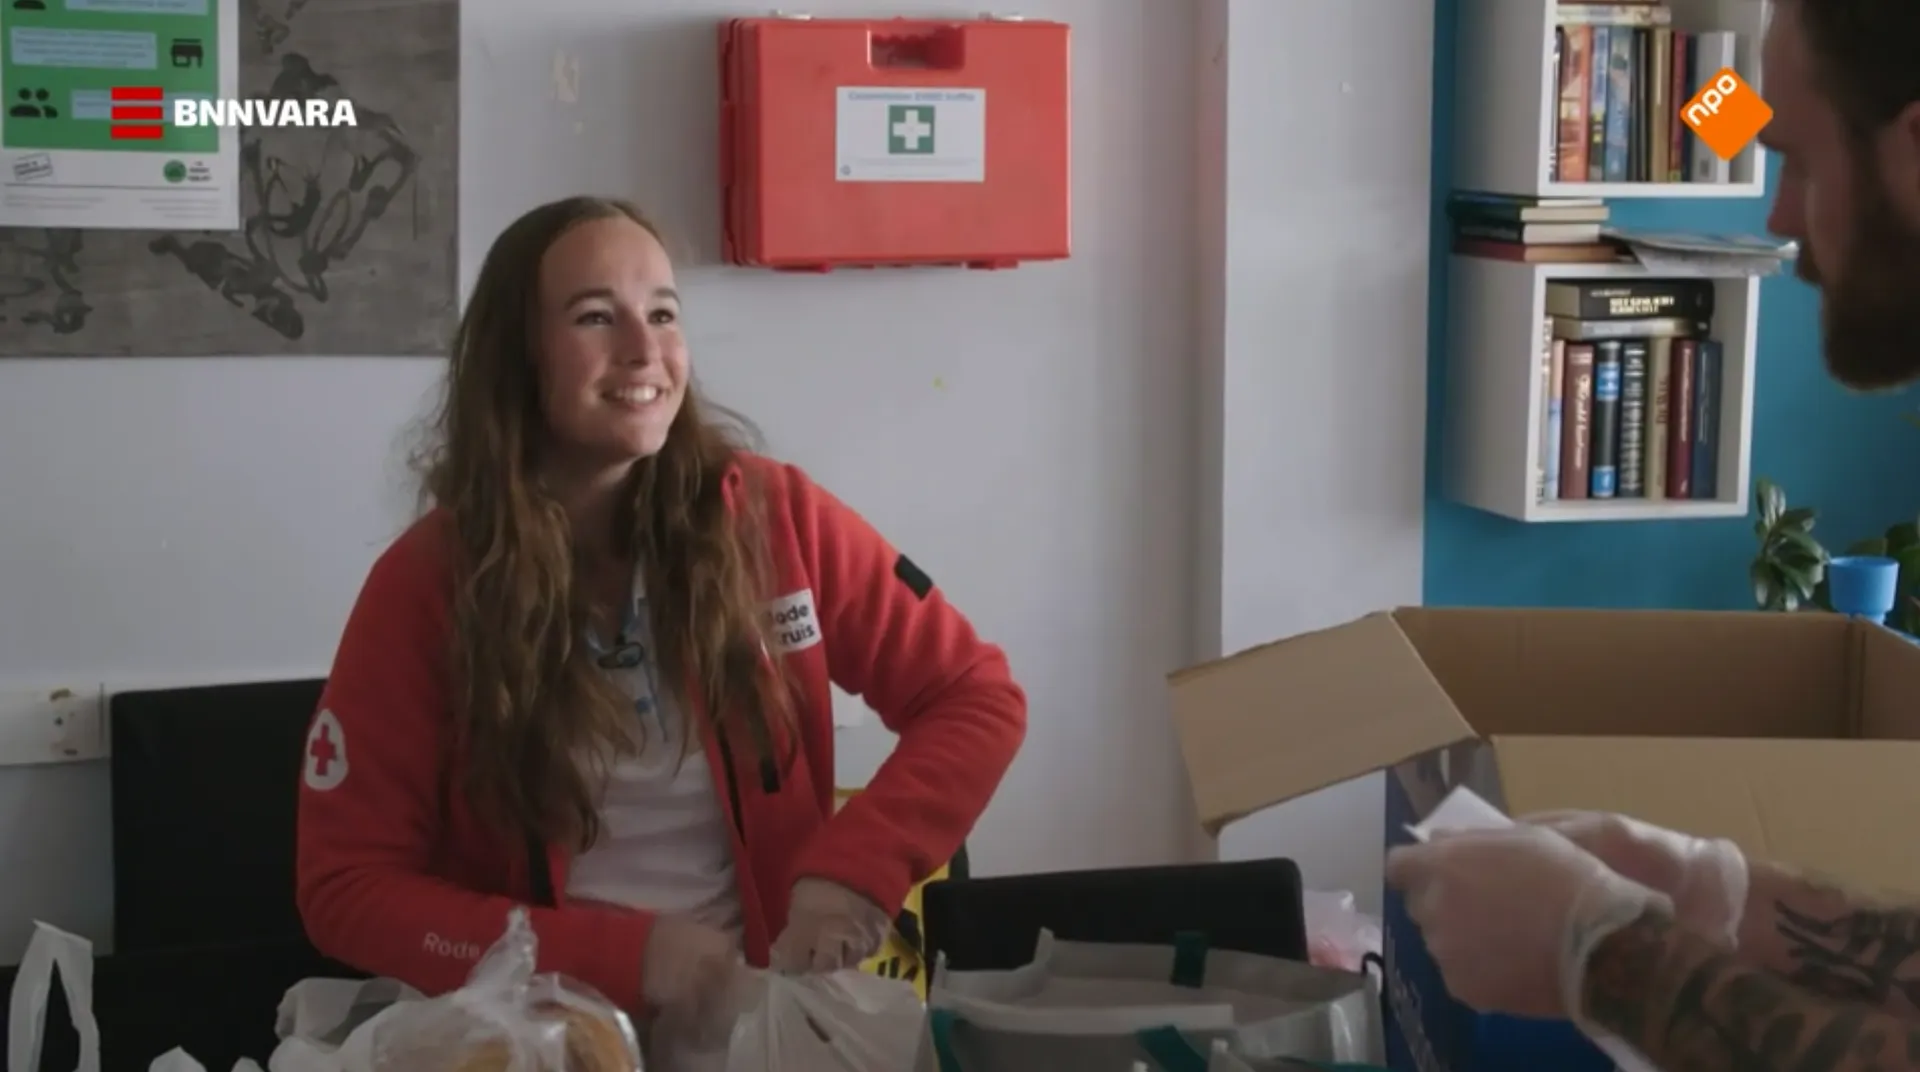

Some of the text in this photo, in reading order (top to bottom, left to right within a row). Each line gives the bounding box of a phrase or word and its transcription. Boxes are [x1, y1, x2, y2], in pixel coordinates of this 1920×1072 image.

[776, 605, 809, 624] ode
[781, 624, 815, 644] ruis
[422, 931, 481, 960] Rode
